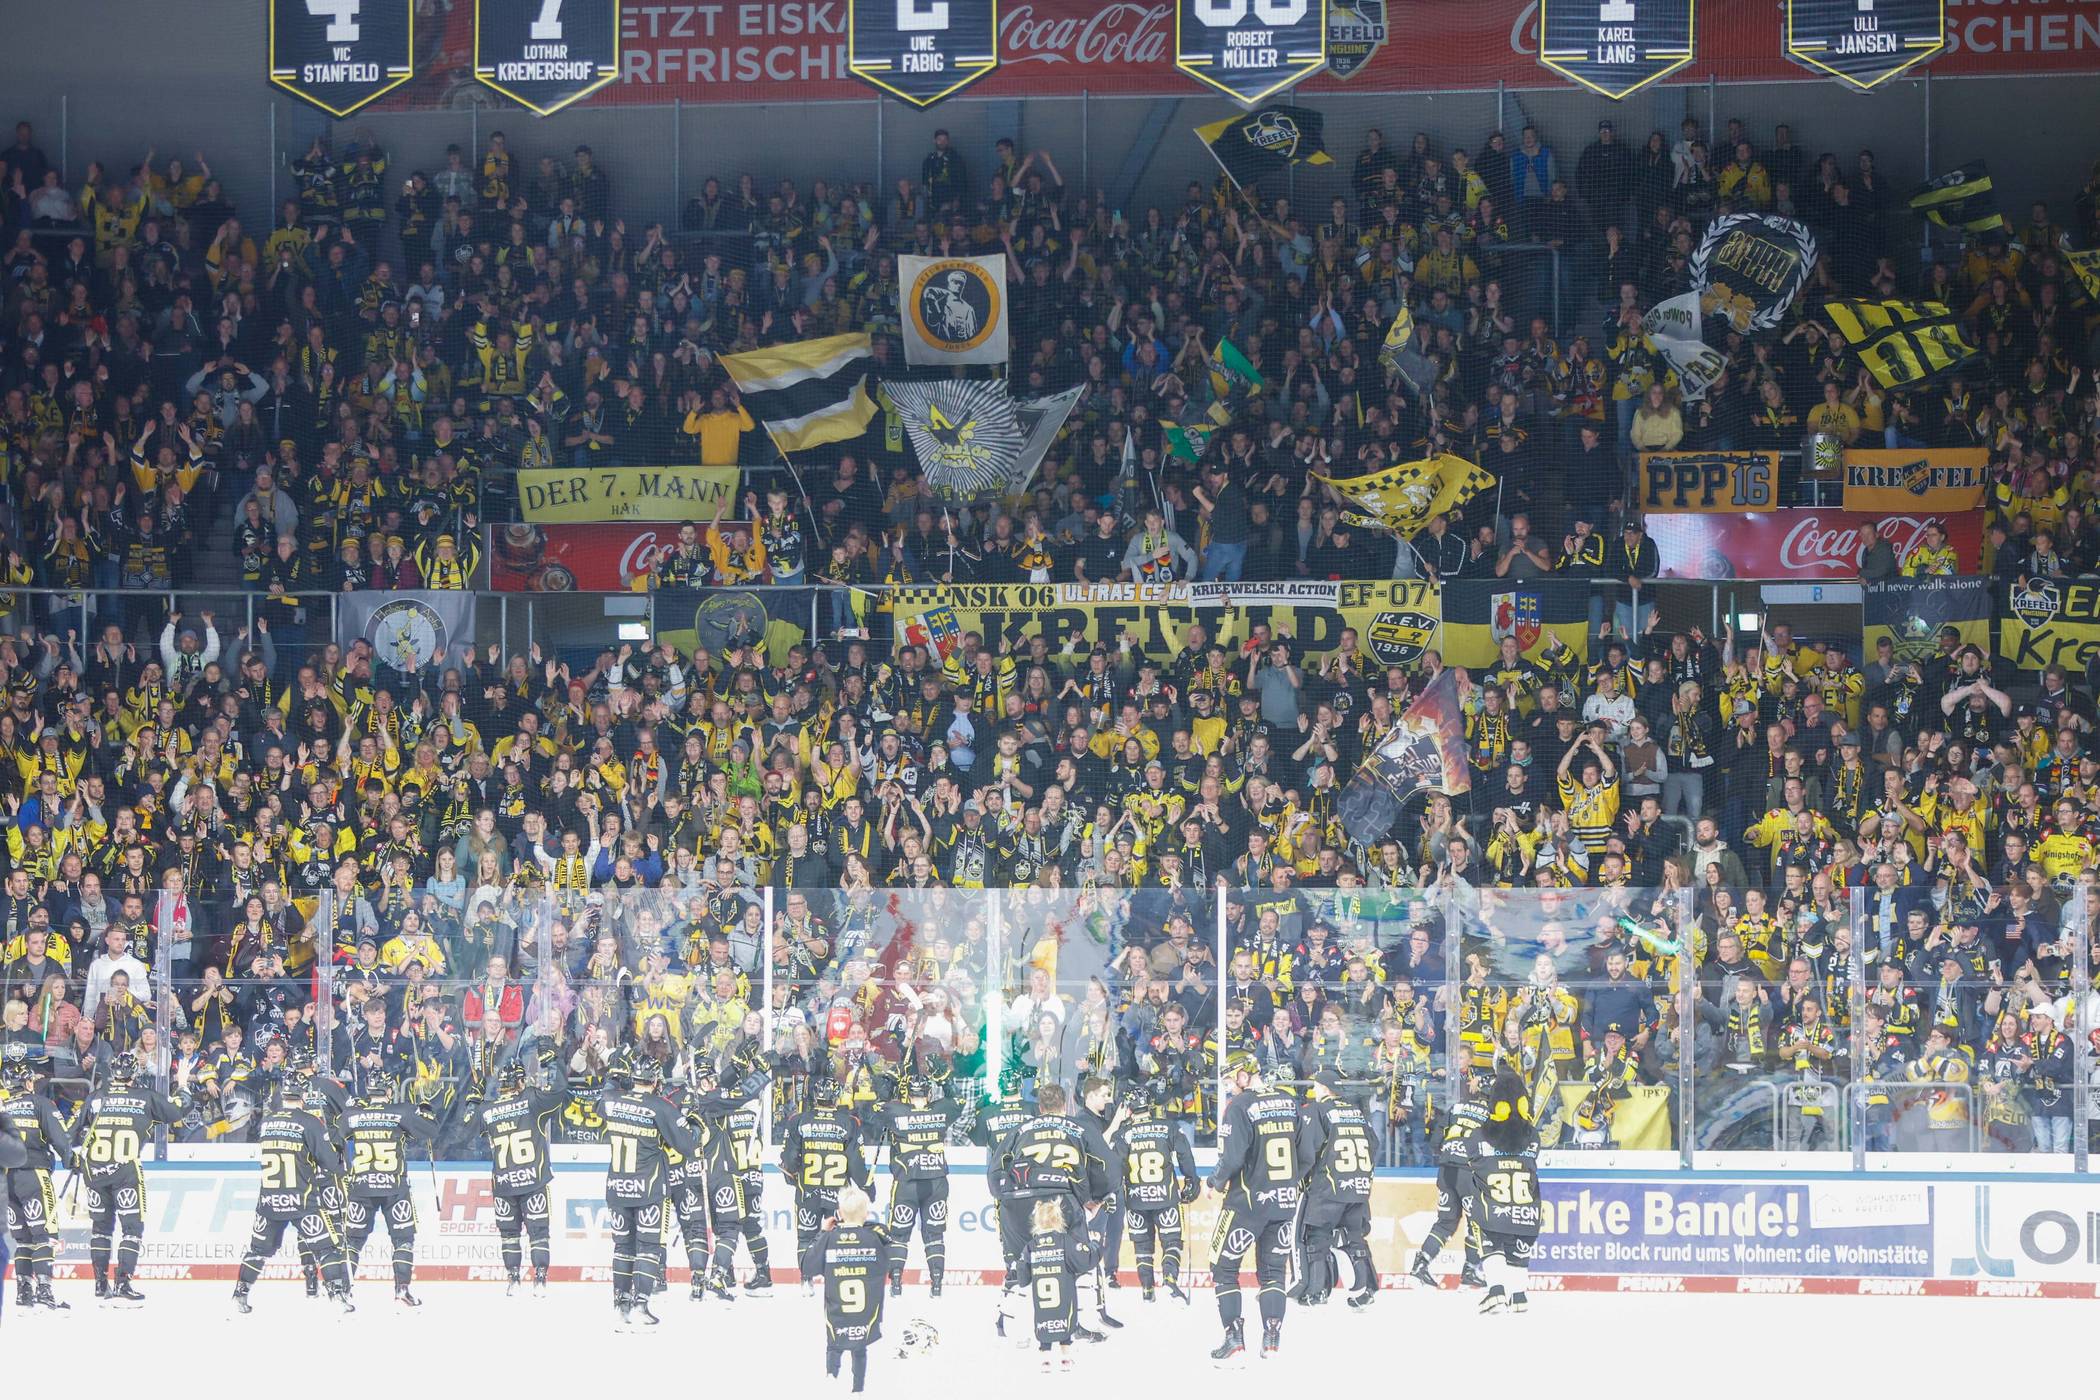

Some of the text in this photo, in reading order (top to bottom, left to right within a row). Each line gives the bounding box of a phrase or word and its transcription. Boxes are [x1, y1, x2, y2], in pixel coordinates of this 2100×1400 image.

[1854, 16, 1878, 32] ULLI
[1227, 31, 1274, 47] ROBERT
[1599, 27, 1636, 42] KAREL
[910, 37, 936, 51] UWE
[1836, 33, 1897, 54] JANSEN
[333, 47, 352, 62] VIC
[523, 45, 567, 60] LOTHAR
[1222, 48, 1278, 68] MÜLLER
[1597, 44, 1636, 64] LANG
[498, 61, 593, 81] KREMERSHOF
[902, 53, 944, 72] FABIG
[304, 64, 379, 83] STANFIELD
[525, 473, 731, 511] DER 7. MANN
[1646, 463, 1771, 507] PPP 16
[1065, 583, 1138, 602] ULTRAS
[1192, 581, 1337, 597] KRIEEWELSCH ACTION
[1812, 586, 1823, 602] B
[1887, 582, 1915, 593] never
[1918, 578, 1947, 591] walk
[1950, 578, 1982, 590] alone
[951, 586, 1008, 607] NSK
[1340, 582, 1429, 609] EF-07
[2012, 598, 2058, 611] KREFELD
[1382, 612, 1433, 631] K.E.V.
[1376, 642, 1408, 656] 1936
[565, 1102, 604, 1128] 45
[576, 1131, 599, 1141] EGN
[908, 1132, 939, 1143] MILLER
[494, 1130, 536, 1169] 76
[610, 1135, 638, 1173] 11
[1131, 1140, 1156, 1151] MAYR
[353, 1141, 398, 1173] 25
[920, 1153, 944, 1167] EGN
[1266, 1137, 1293, 1181] 9
[1333, 1138, 1372, 1172] 35
[261, 1153, 297, 1189] 21
[804, 1153, 848, 1187] 22
[1128, 1151, 1165, 1184] 18
[1498, 1160, 1523, 1170] KEVIN
[368, 1174, 396, 1184] EGN
[510, 1168, 537, 1182] EGN
[616, 1179, 645, 1192] EGN
[1140, 1185, 1168, 1198] EGN
[1487, 1171, 1534, 1205] 36
[273, 1194, 301, 1207] EGN
[1511, 1206, 1540, 1220] EGN
[1643, 1190, 1800, 1238] Bande!
[1550, 1242, 1602, 1260] erster
[1605, 1241, 1651, 1261] Block
[1653, 1244, 1692, 1262] rund
[1695, 1249, 1730, 1263] ums
[1733, 1244, 1802, 1264] Wohnen:
[1805, 1244, 1831, 1264] die
[1833, 1244, 1929, 1265] Wohnstätte
[1035, 1277, 1062, 1308] 9
[1617, 1277, 1685, 1293] PENNY.
[1737, 1278, 1804, 1295] PENNY.
[1858, 1279, 1925, 1296] PENNY.
[1976, 1281, 2044, 1298] PENNY.
[839, 1279, 866, 1313] 9
[848, 1326, 869, 1337] EGN
[1046, 1319, 1068, 1330] EGN
